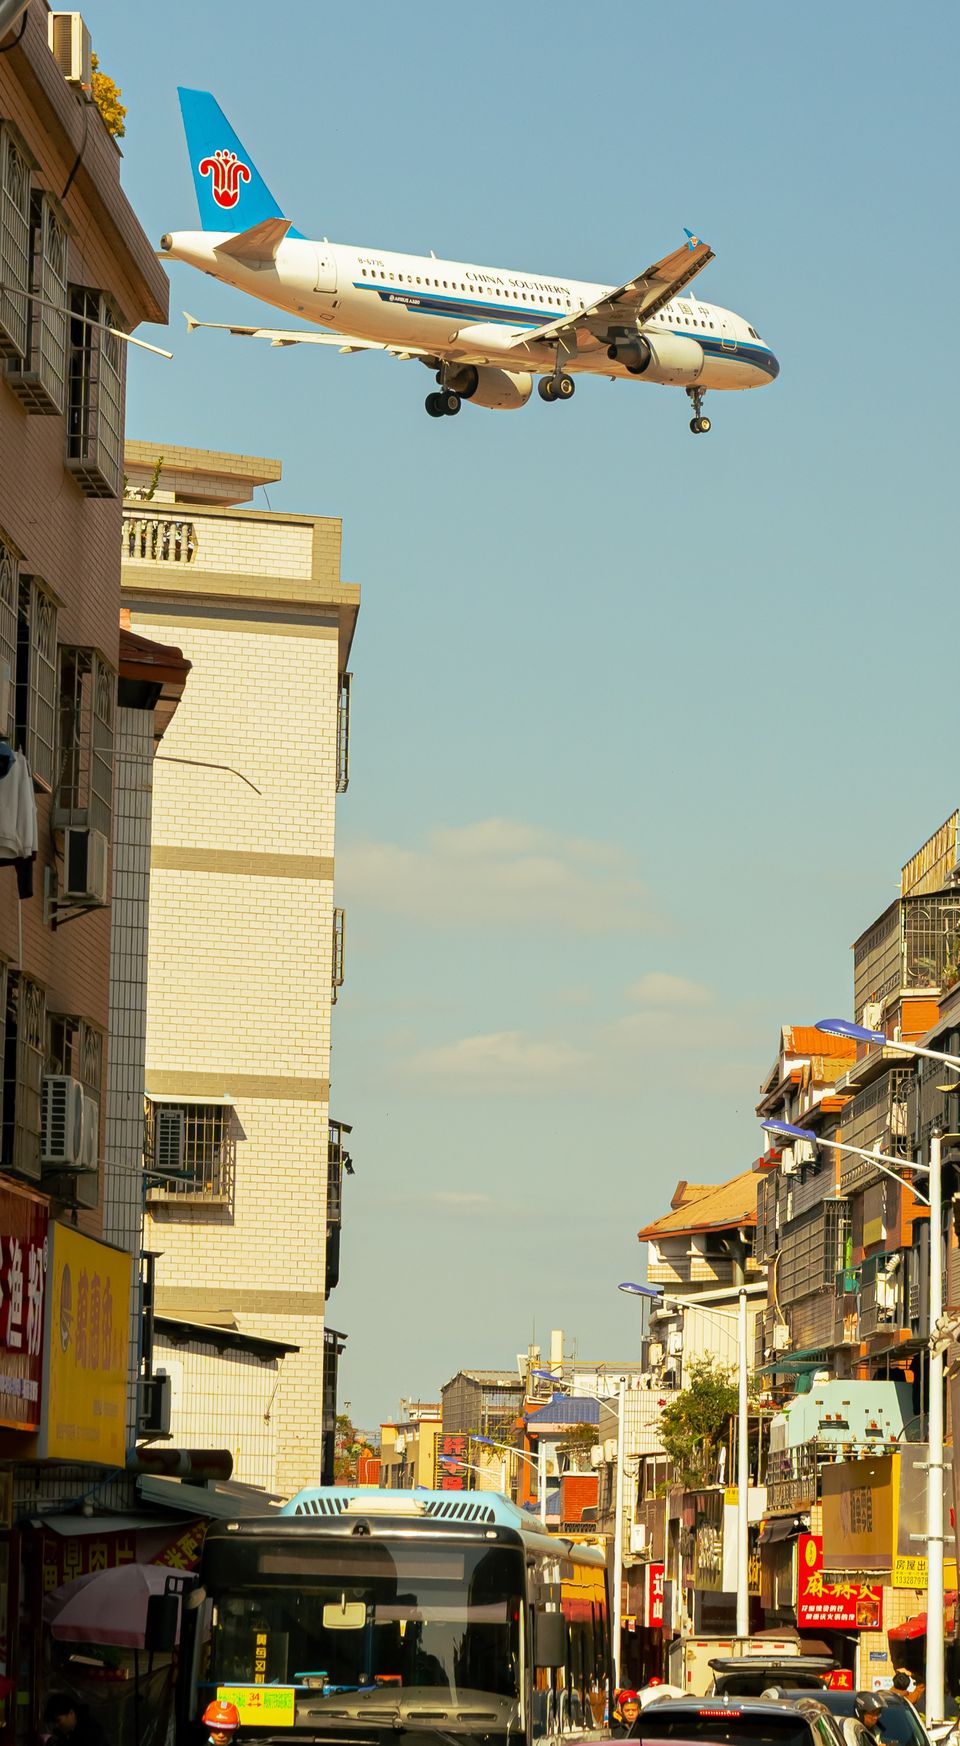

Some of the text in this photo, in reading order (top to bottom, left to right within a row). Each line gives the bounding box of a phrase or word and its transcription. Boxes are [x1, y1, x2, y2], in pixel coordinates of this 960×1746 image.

[465, 271, 571, 296] CHINA SOUTHERN
[896, 1559, 928, 1571] 房屋出
[249, 1692, 260, 1702] 34
